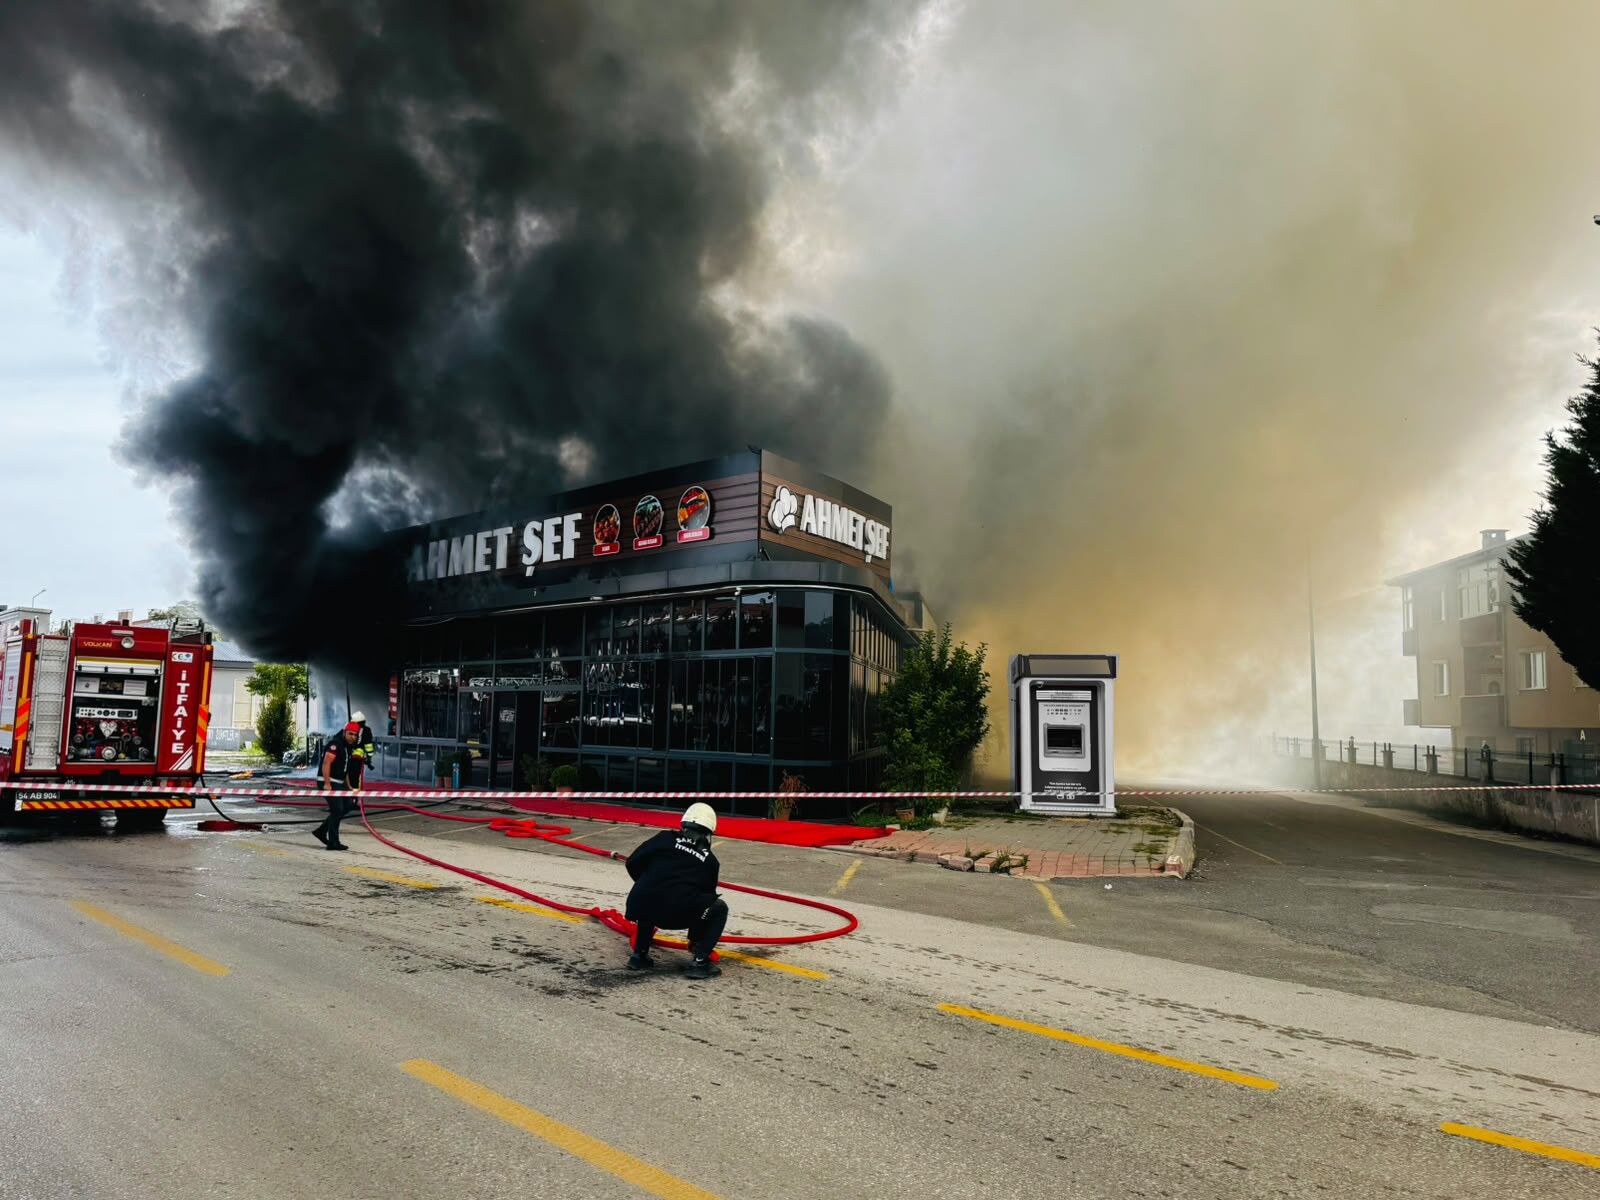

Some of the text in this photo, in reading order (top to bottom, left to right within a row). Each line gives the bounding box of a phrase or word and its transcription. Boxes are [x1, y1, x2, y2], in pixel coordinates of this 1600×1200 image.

[522, 512, 582, 577] ŞEF
[800, 494, 890, 563] AHMET ŞEF
